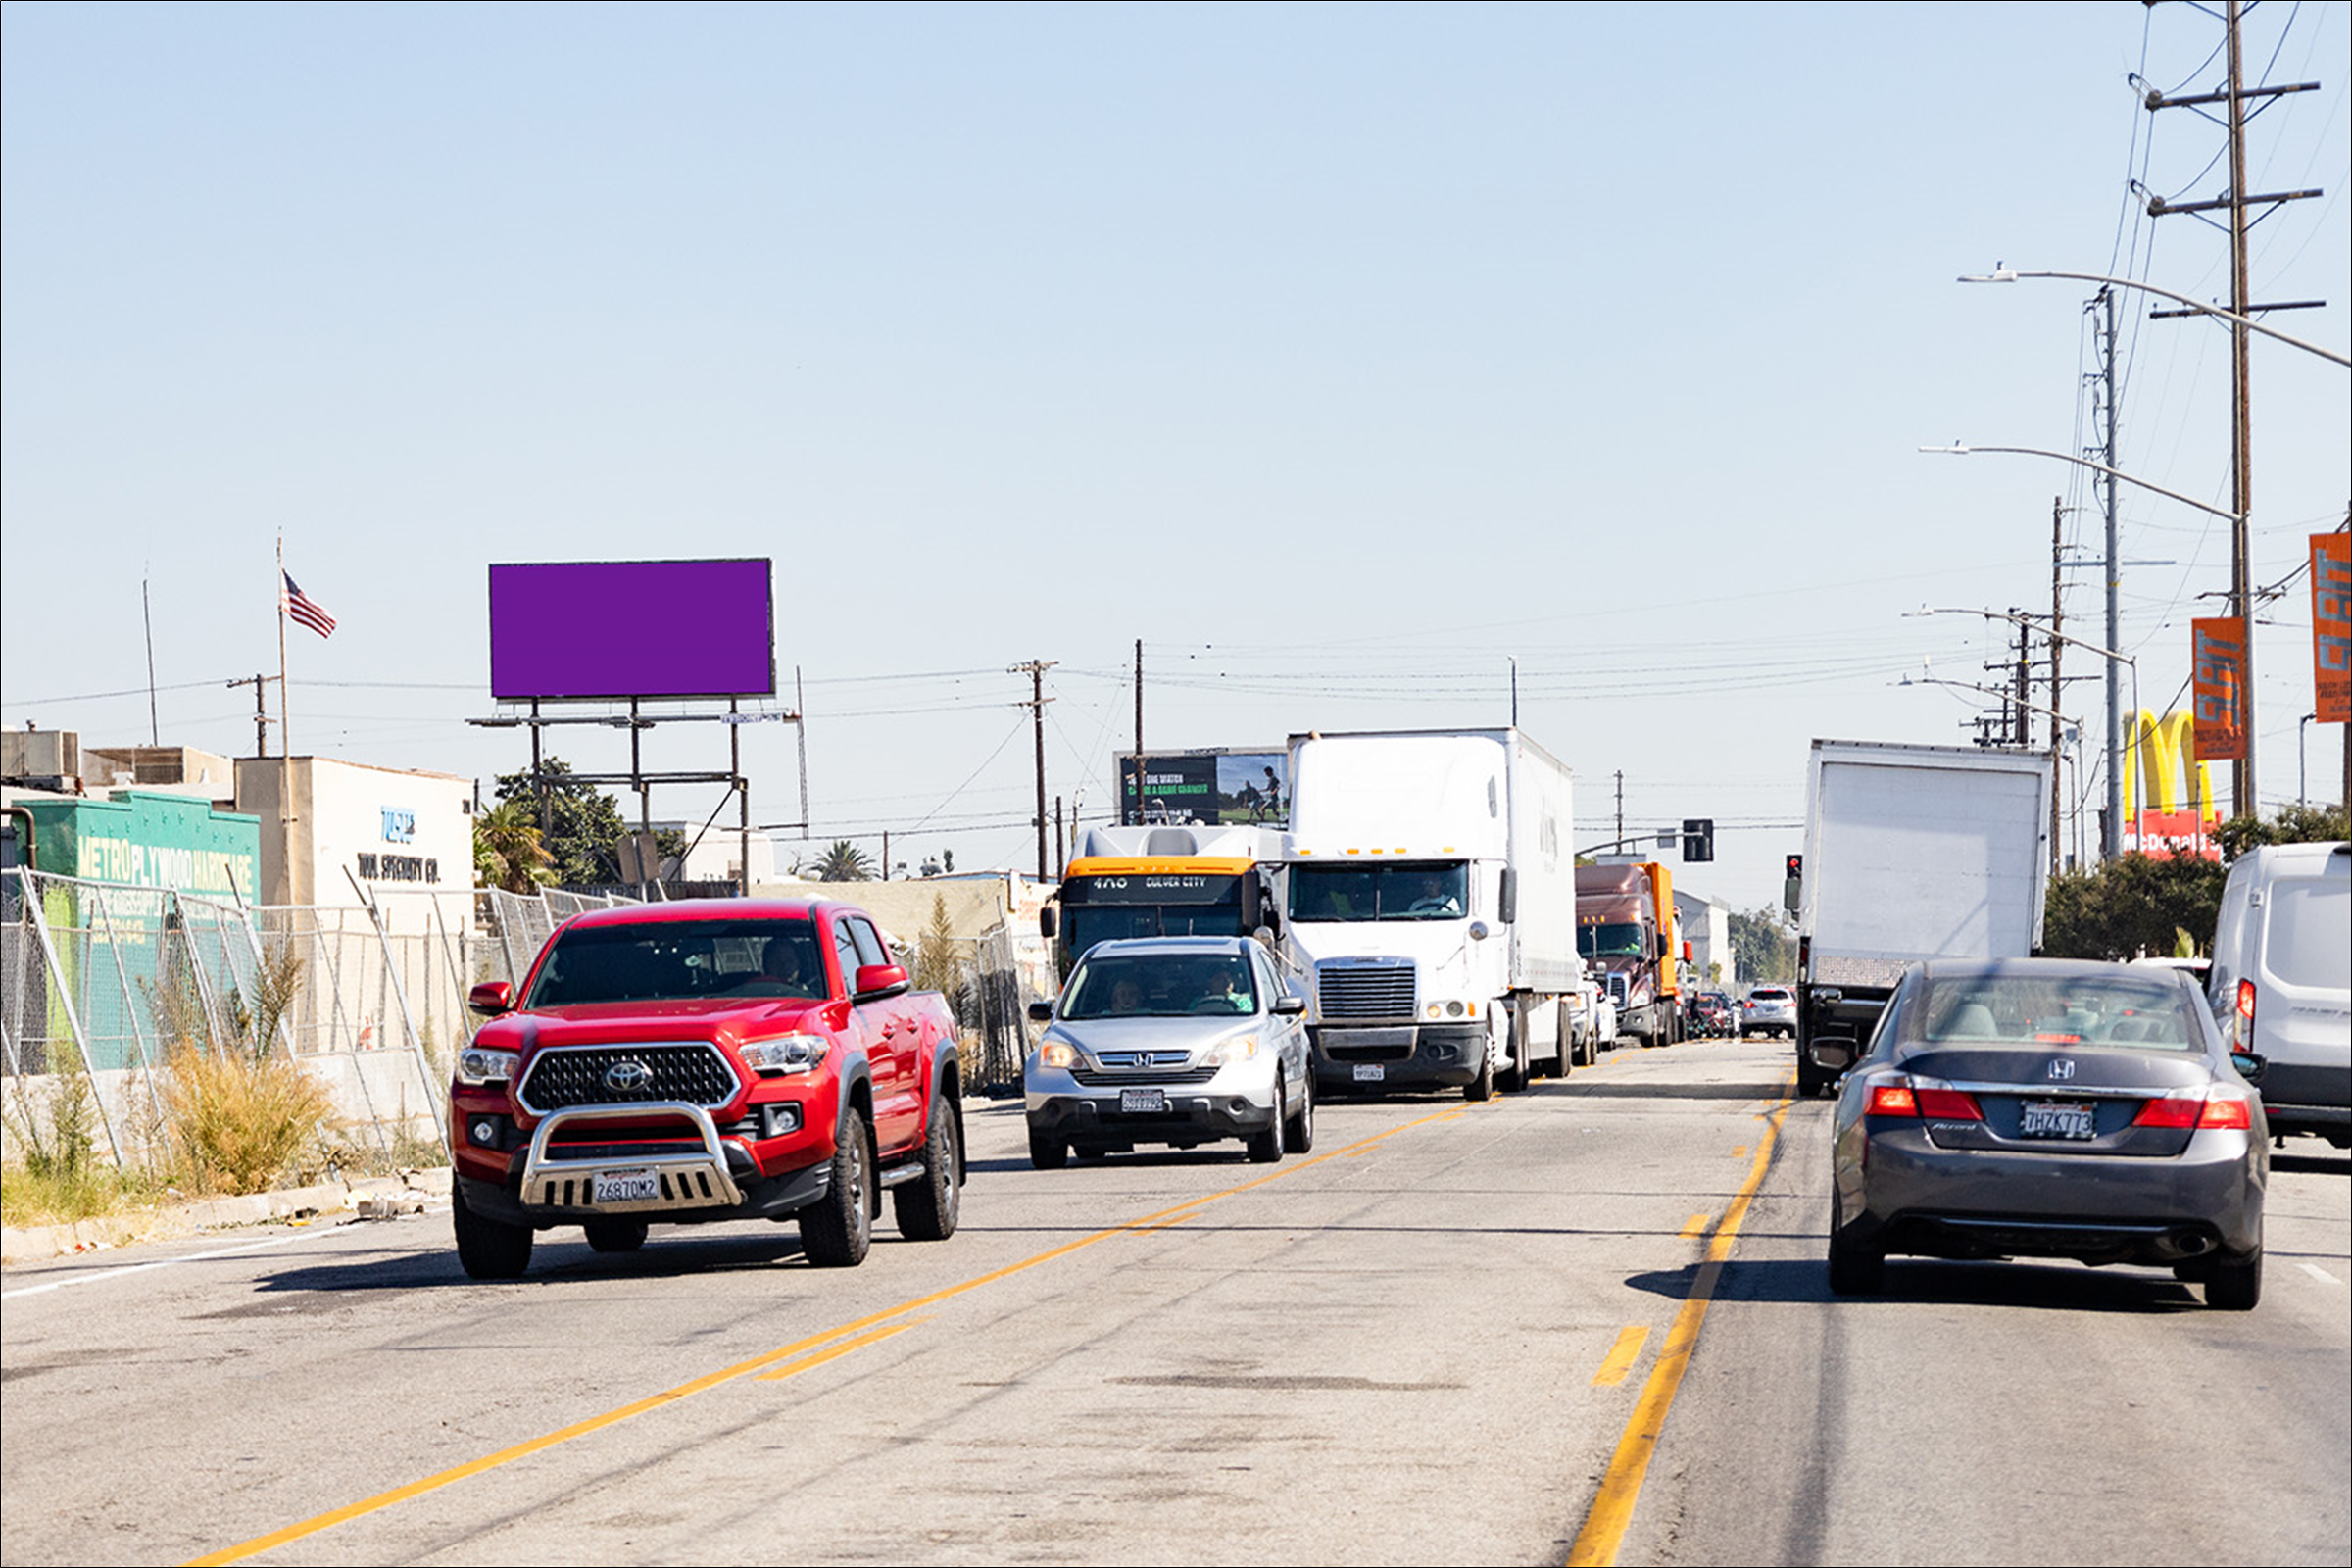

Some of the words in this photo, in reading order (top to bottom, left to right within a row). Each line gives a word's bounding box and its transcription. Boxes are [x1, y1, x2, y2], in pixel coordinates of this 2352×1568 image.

[2123, 832, 2220, 853] McDonalds
[78, 835, 131, 881] METRO
[130, 844, 193, 889] PLYWOOD
[193, 850, 252, 893] HARDWARE
[1182, 876, 1206, 888] CITY
[2027, 1110, 2093, 1132] 7HZK773
[598, 1179, 656, 1200] 26870M2
